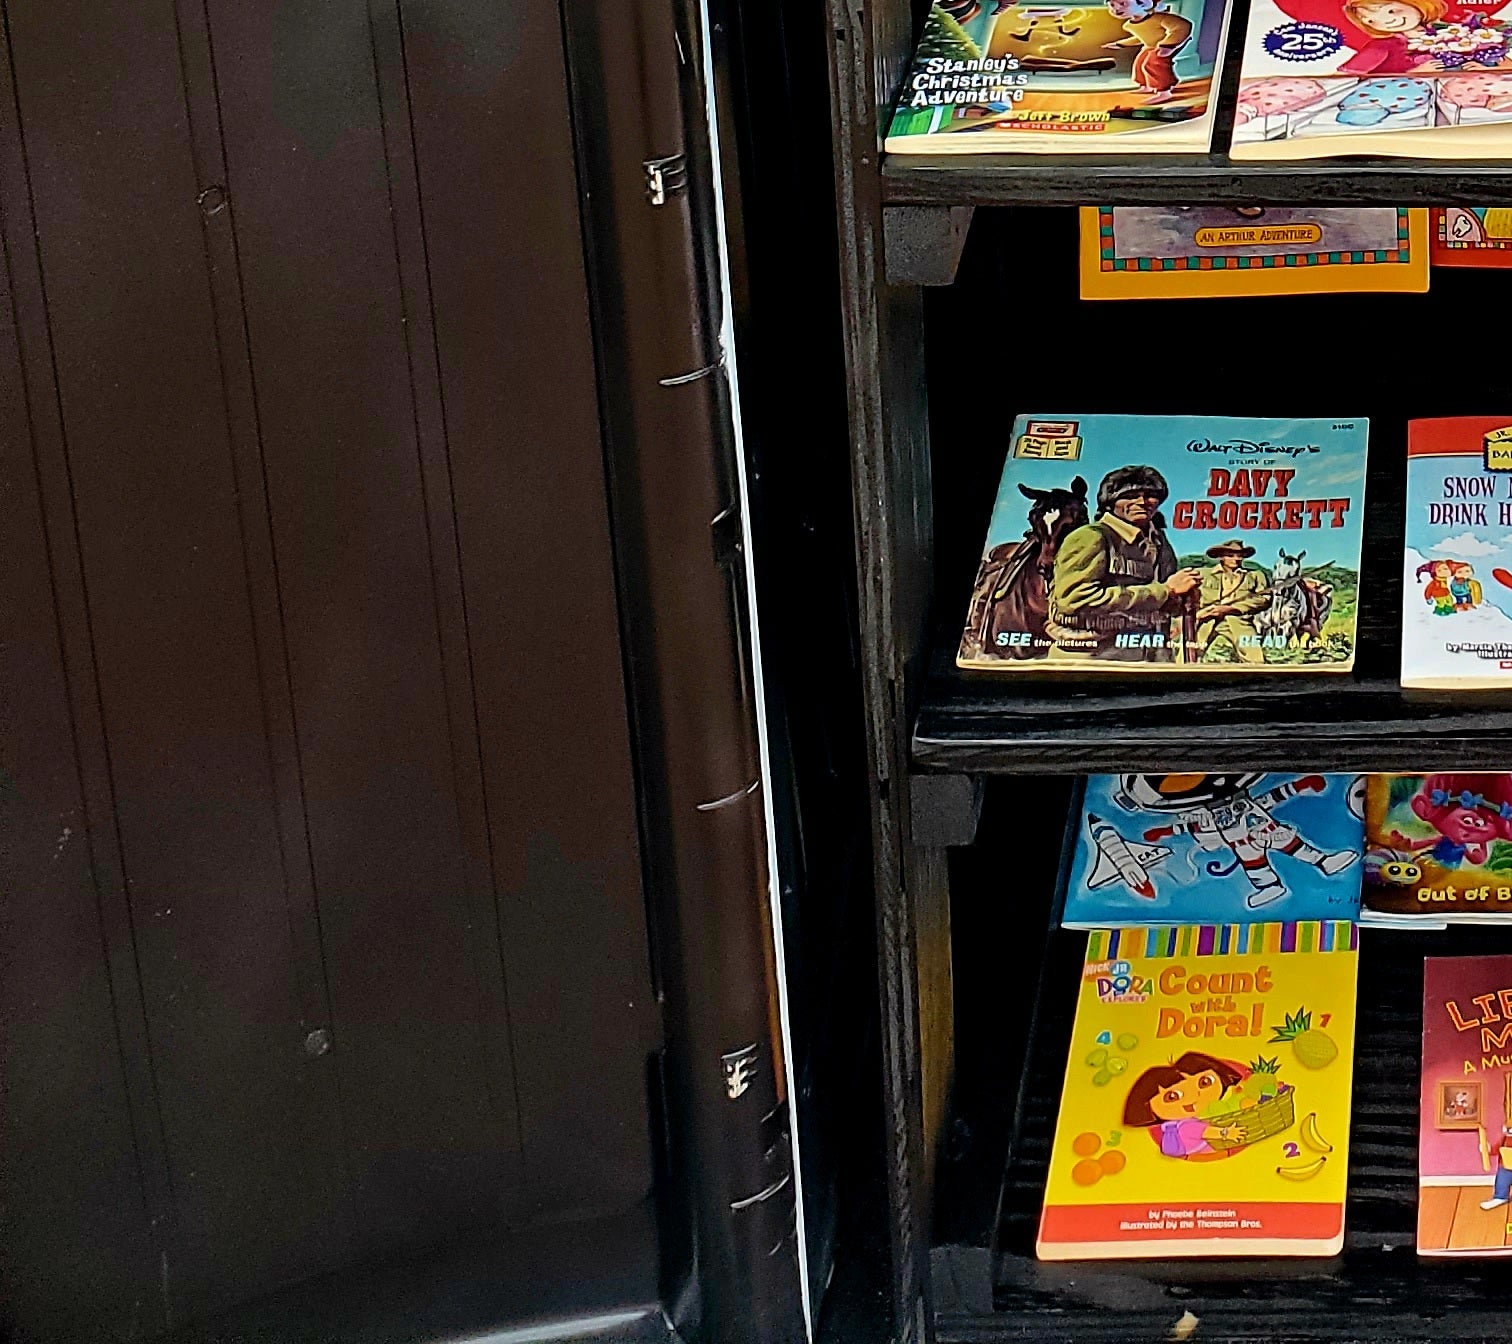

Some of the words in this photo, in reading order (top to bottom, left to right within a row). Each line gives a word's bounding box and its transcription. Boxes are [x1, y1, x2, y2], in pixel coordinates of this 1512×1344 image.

[925, 53, 1020, 75] Stanley's
[912, 72, 1029, 91] Christmas
[910, 88, 1025, 108] Adventure
[1206, 467, 1297, 498] DAVY
[1442, 474, 1498, 501] SNOW
[1172, 497, 1352, 531] CROCKETT
[1428, 501, 1490, 528] DRINK
[1114, 633, 1166, 650] HEAR
[1136, 847, 1162, 863] CAT
[1416, 885, 1458, 903] Out
[1464, 885, 1490, 902] of
[1096, 975, 1155, 998] DORA
[1158, 965, 1275, 996] Count
[1189, 996, 1238, 1014] with
[1156, 1002, 1266, 1039] Dora!
[1462, 1059, 1478, 1077] A
